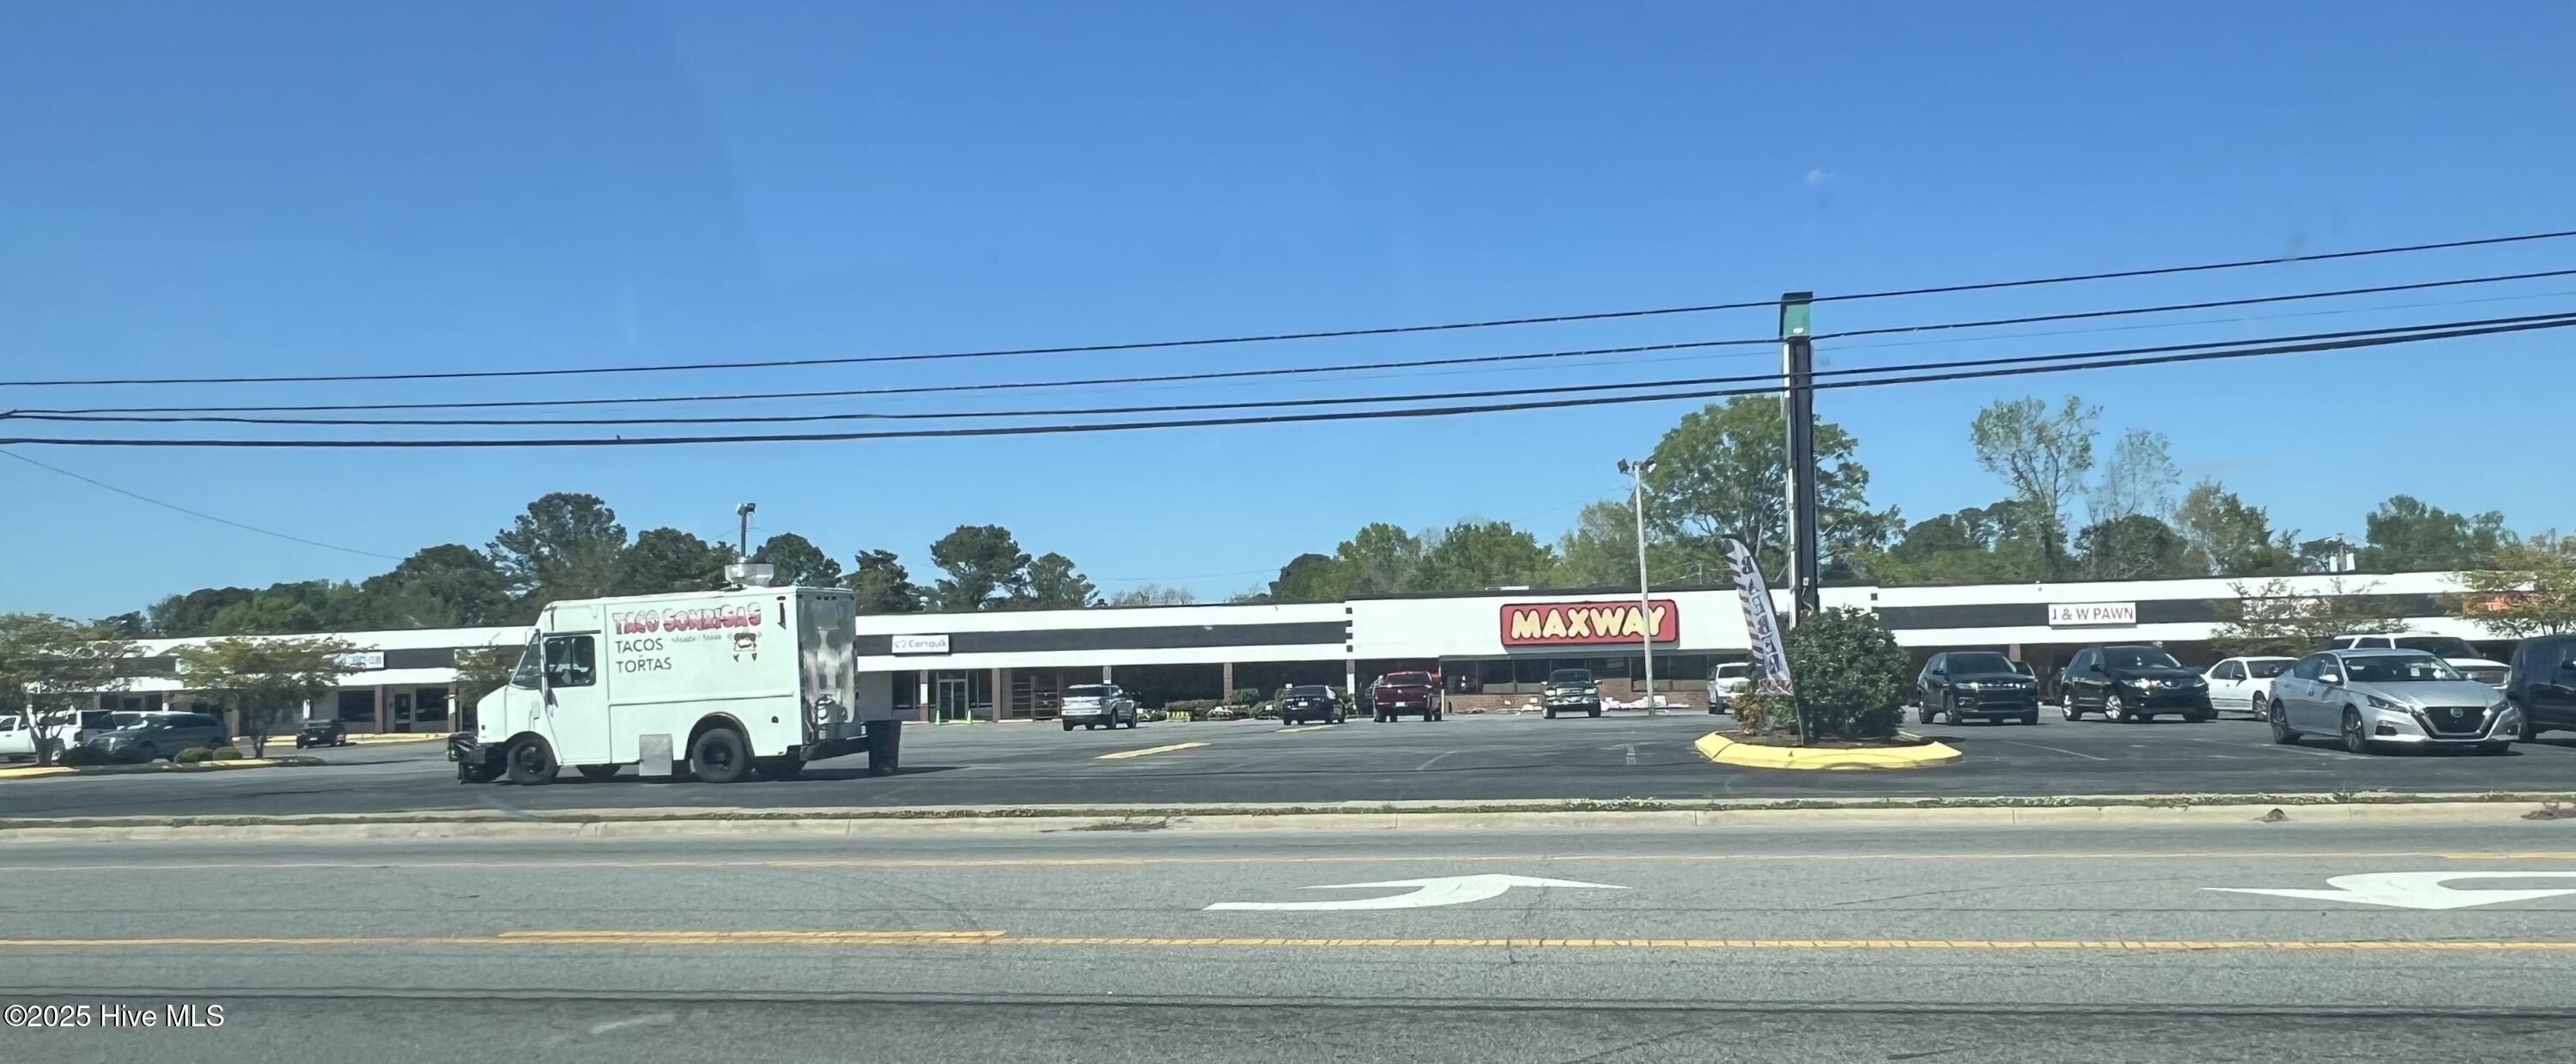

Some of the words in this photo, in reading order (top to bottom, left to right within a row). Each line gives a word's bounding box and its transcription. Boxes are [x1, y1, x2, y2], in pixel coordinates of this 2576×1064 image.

[612, 610, 659, 635] TACO
[662, 602, 762, 632] SONRISAS
[2052, 608, 2057, 620] J
[2062, 608, 2072, 620] &
[2076, 607, 2089, 620] W
[2093, 607, 2134, 620] PAWN
[1511, 606, 1666, 639] MAXWAY
[616, 638, 664, 654] TACOS
[616, 657, 672, 673] TORTAS
